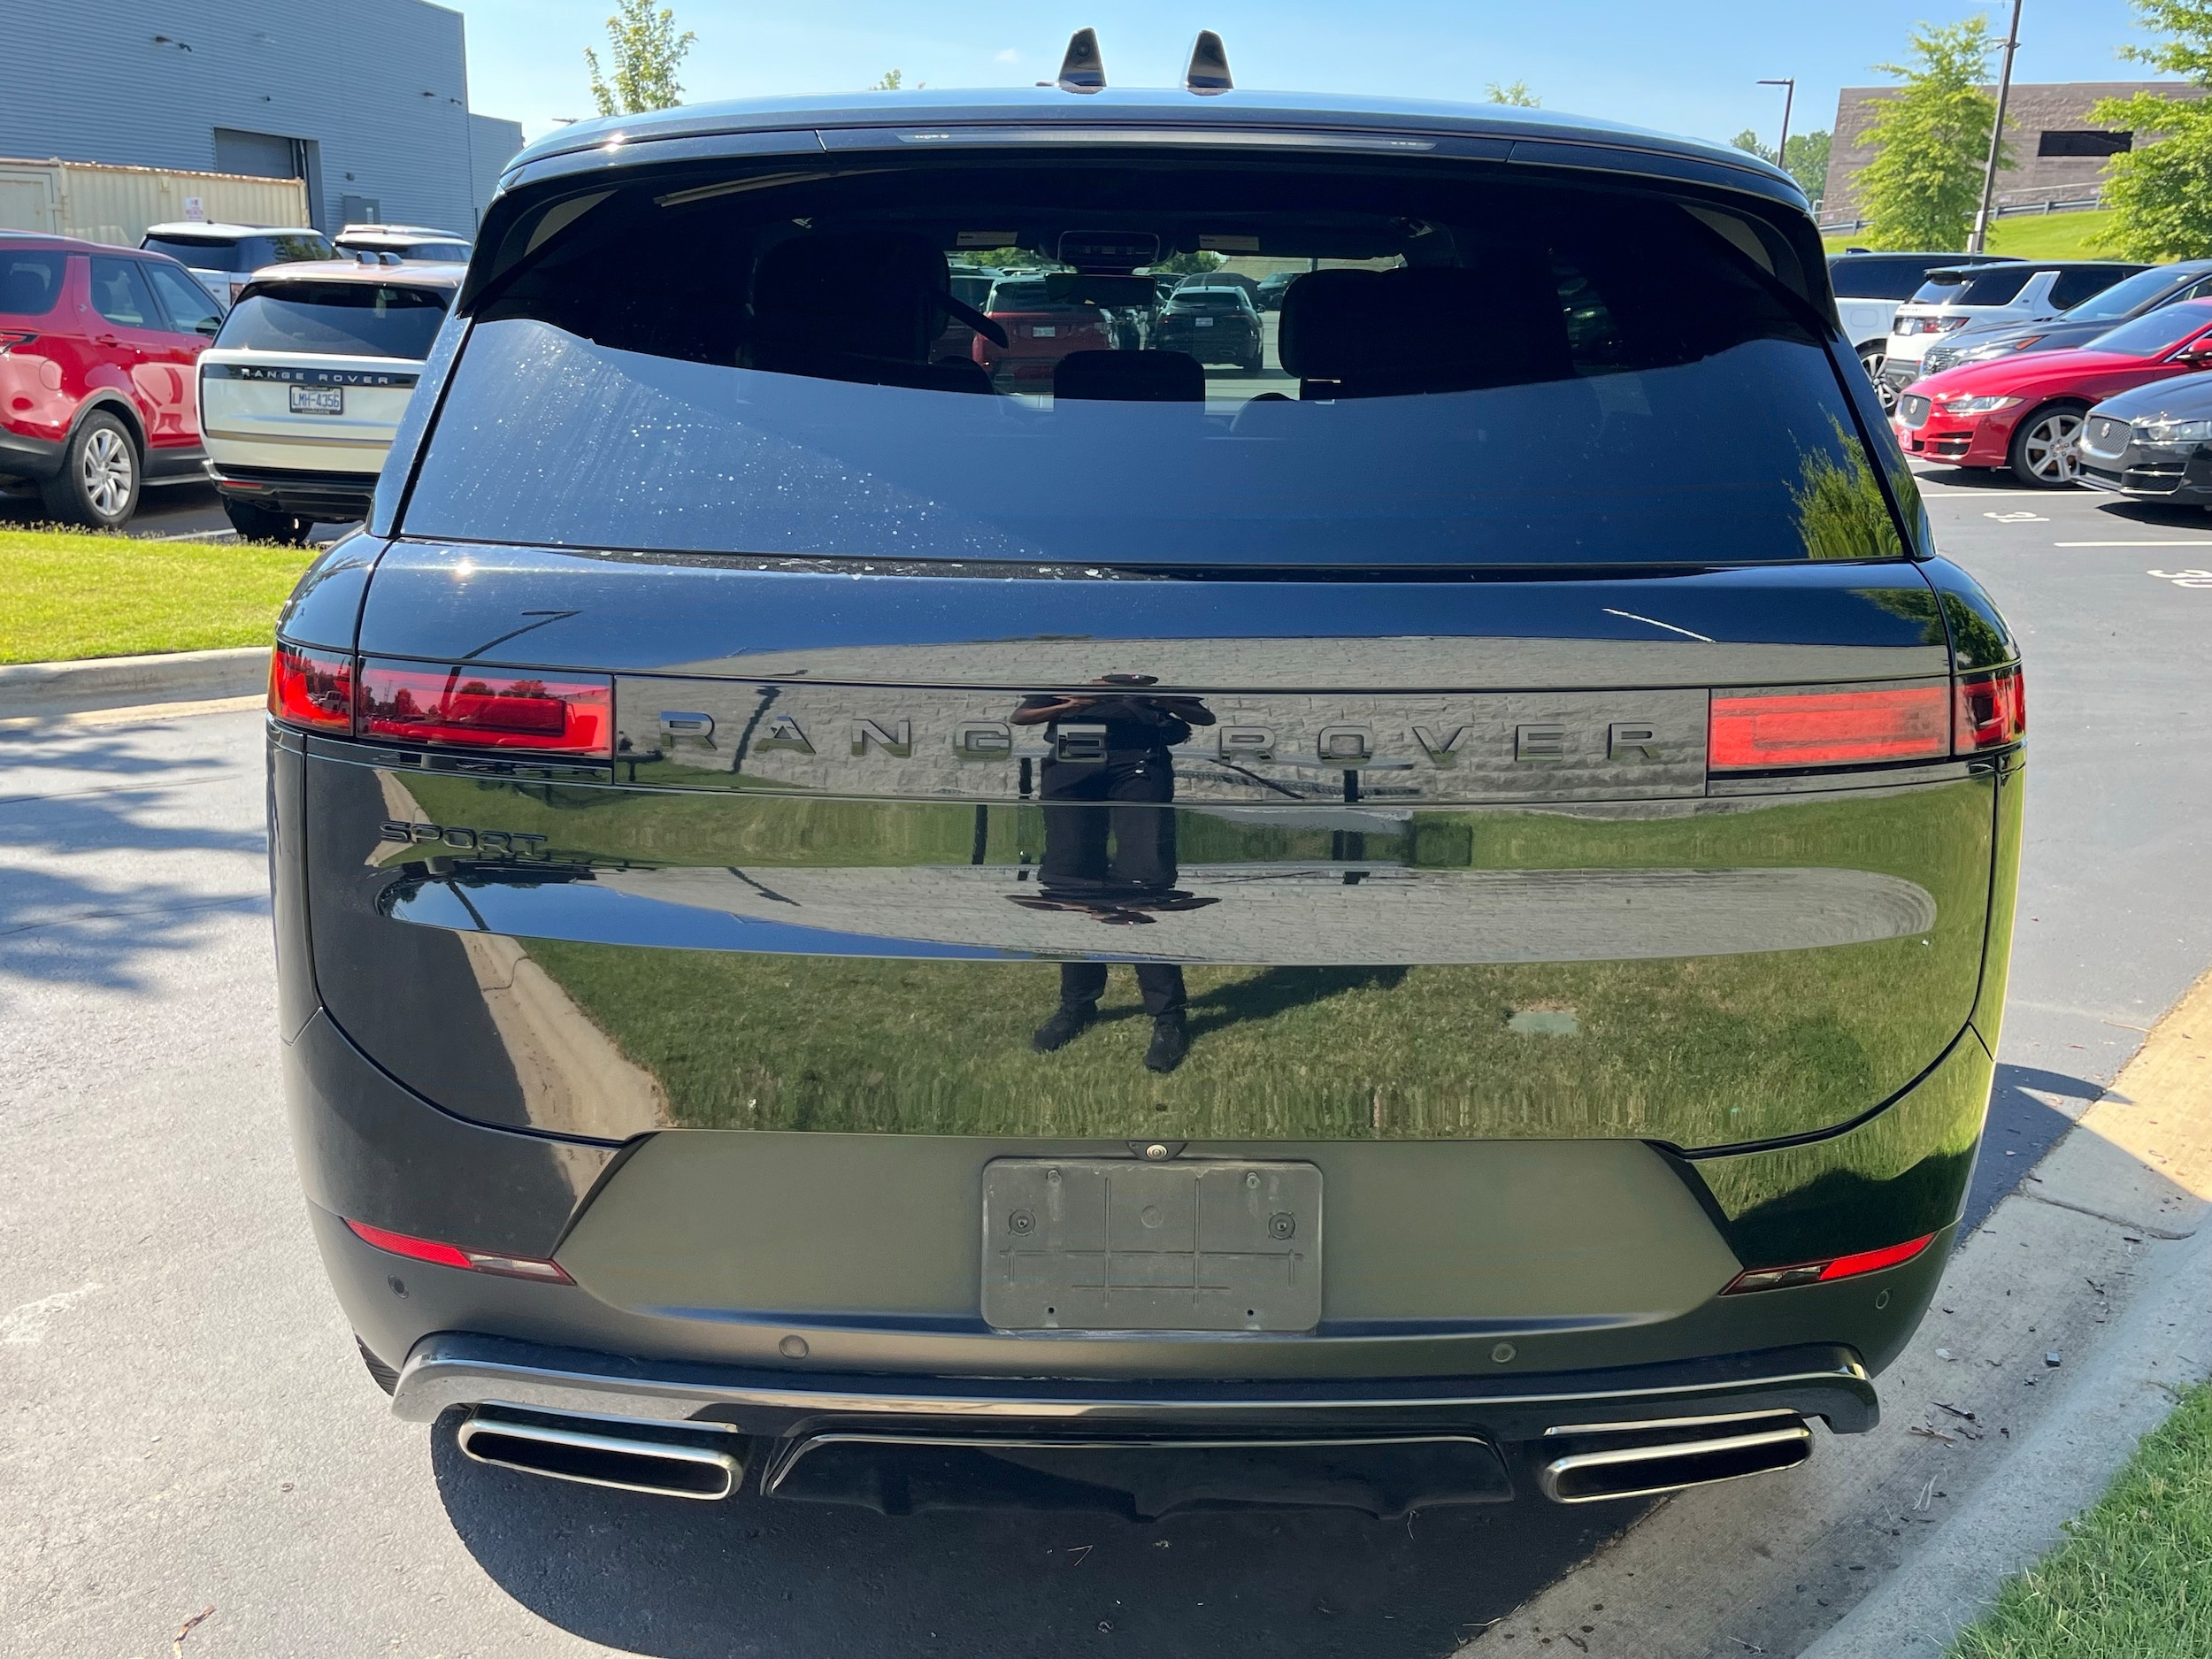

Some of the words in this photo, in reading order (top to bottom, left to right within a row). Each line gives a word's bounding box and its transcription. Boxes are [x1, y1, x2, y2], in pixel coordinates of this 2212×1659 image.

[242, 368, 304, 380] RANGE
[319, 373, 388, 385] ROVER
[292, 393, 340, 408] LMH-4356
[660, 710, 1110, 764] RANGE
[1218, 721, 1663, 768] ROVER
[379, 819, 549, 856] SPORT
